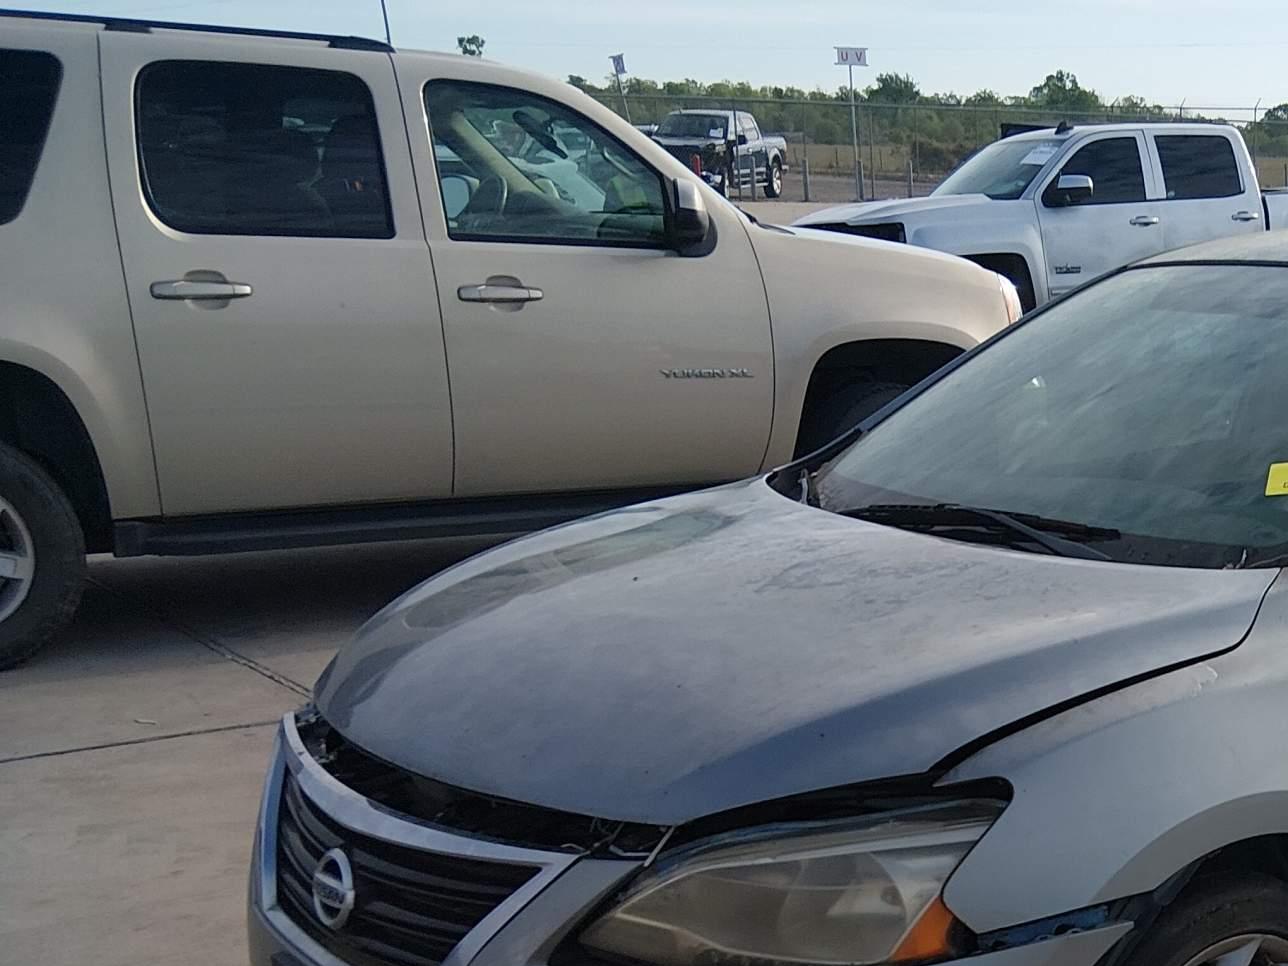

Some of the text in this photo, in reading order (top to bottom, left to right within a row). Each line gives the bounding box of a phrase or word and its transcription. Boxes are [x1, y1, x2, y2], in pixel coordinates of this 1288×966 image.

[841, 51, 862, 62] U V
[660, 367, 755, 379] YUKON XL
